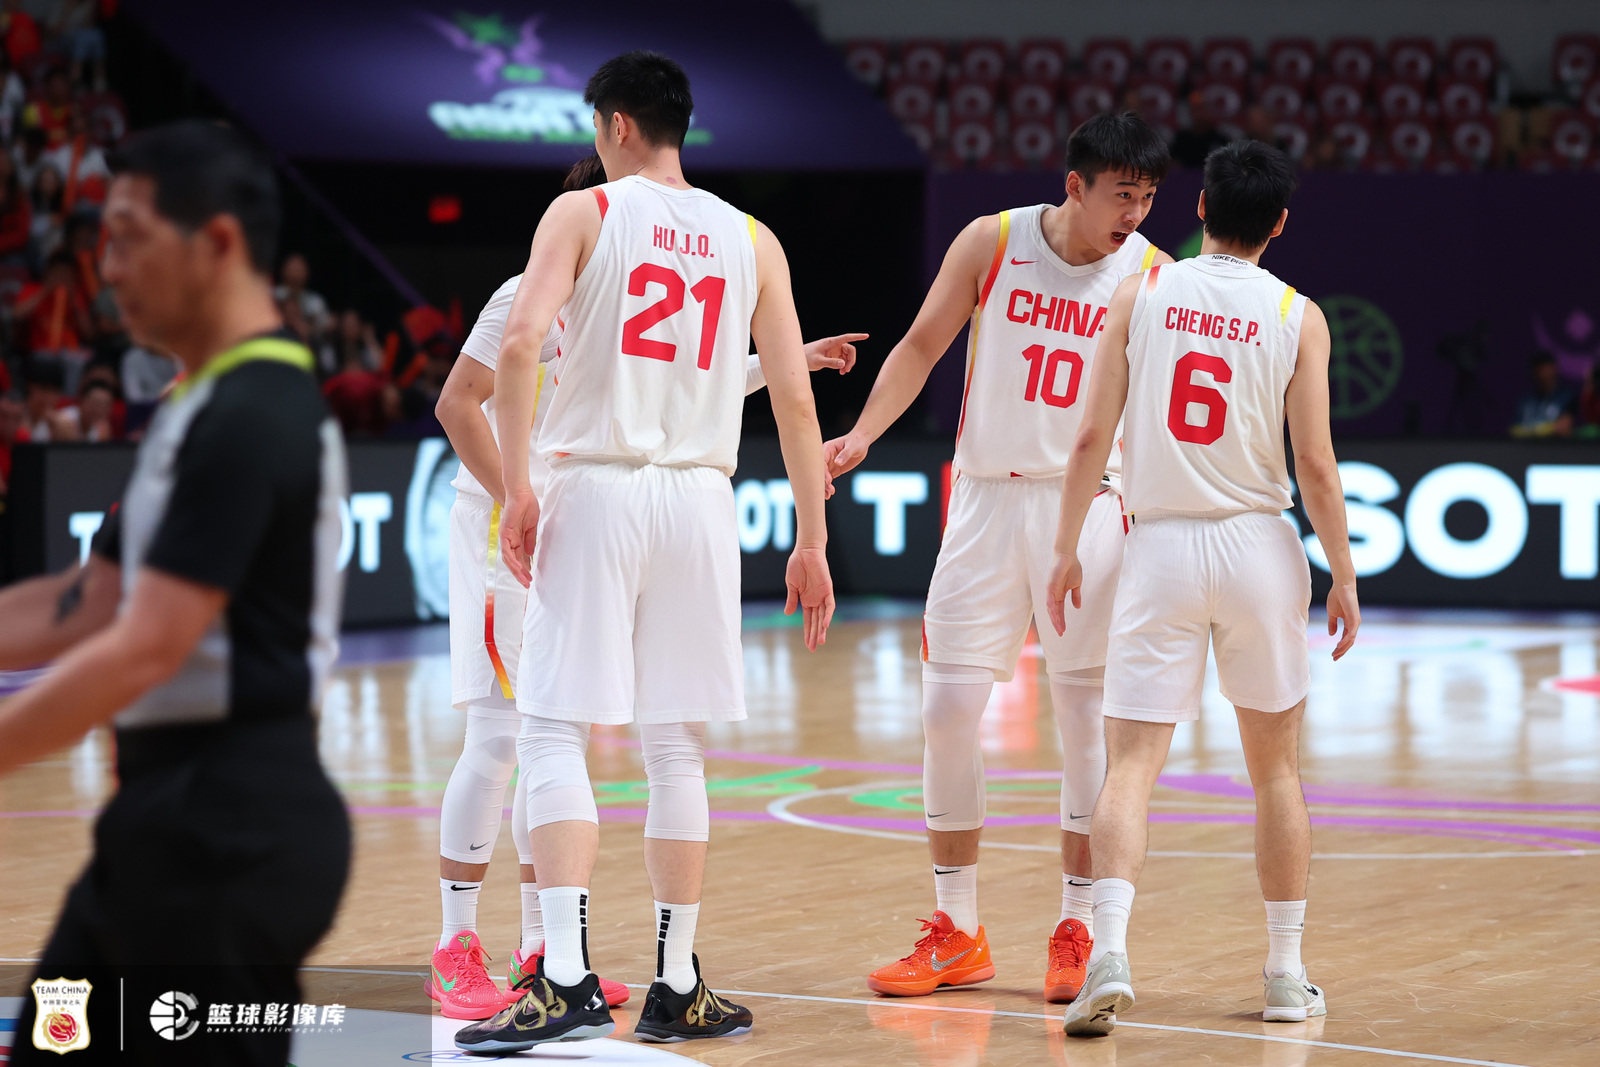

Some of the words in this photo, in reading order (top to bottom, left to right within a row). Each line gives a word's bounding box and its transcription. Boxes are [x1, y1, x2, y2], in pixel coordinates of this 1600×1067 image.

[653, 224, 676, 251] HU
[679, 233, 715, 258] J.Q.
[1230, 257, 1248, 266] PRO
[621, 262, 726, 371] 21
[1165, 306, 1226, 339] CHENG
[1227, 318, 1261, 346] S.P.
[1021, 343, 1084, 409] 10
[1167, 350, 1232, 446] 6
[851, 471, 930, 556] T
